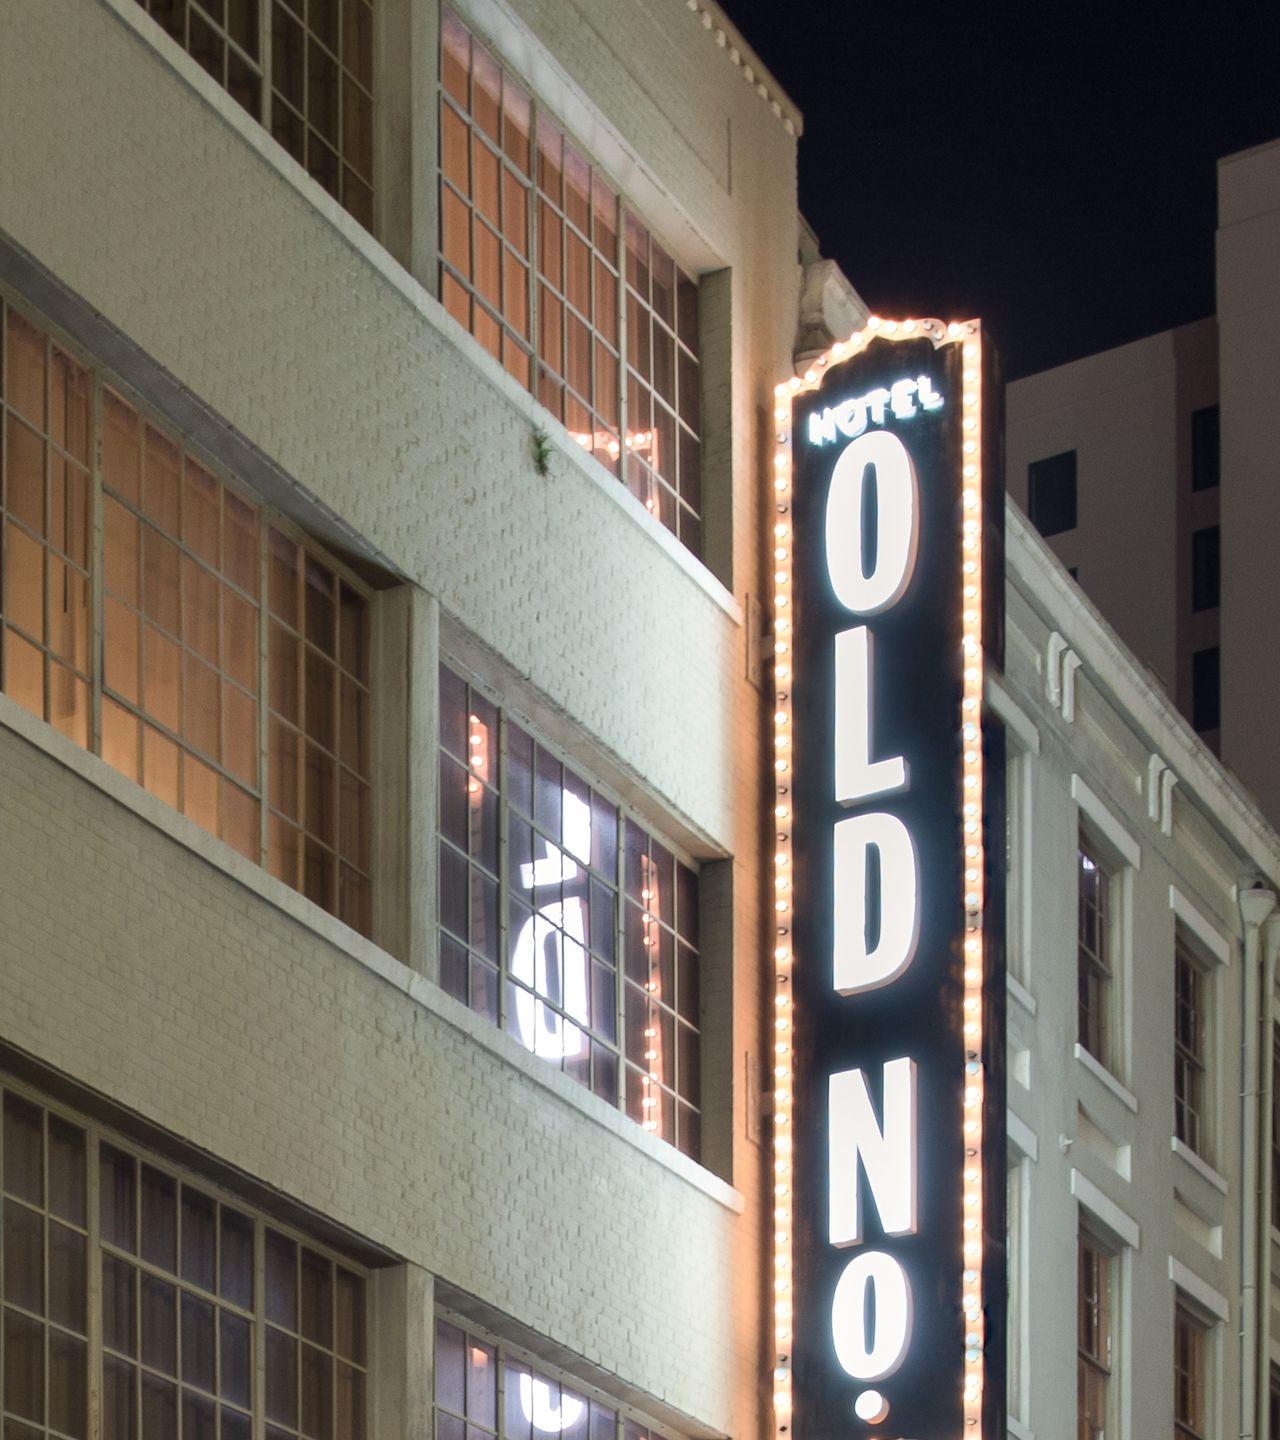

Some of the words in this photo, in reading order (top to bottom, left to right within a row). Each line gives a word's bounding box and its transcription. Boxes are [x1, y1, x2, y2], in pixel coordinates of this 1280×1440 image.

[809, 375, 944, 446] HOTEL
[825, 430, 918, 995] OLD
[827, 1056, 918, 1424] NO.
